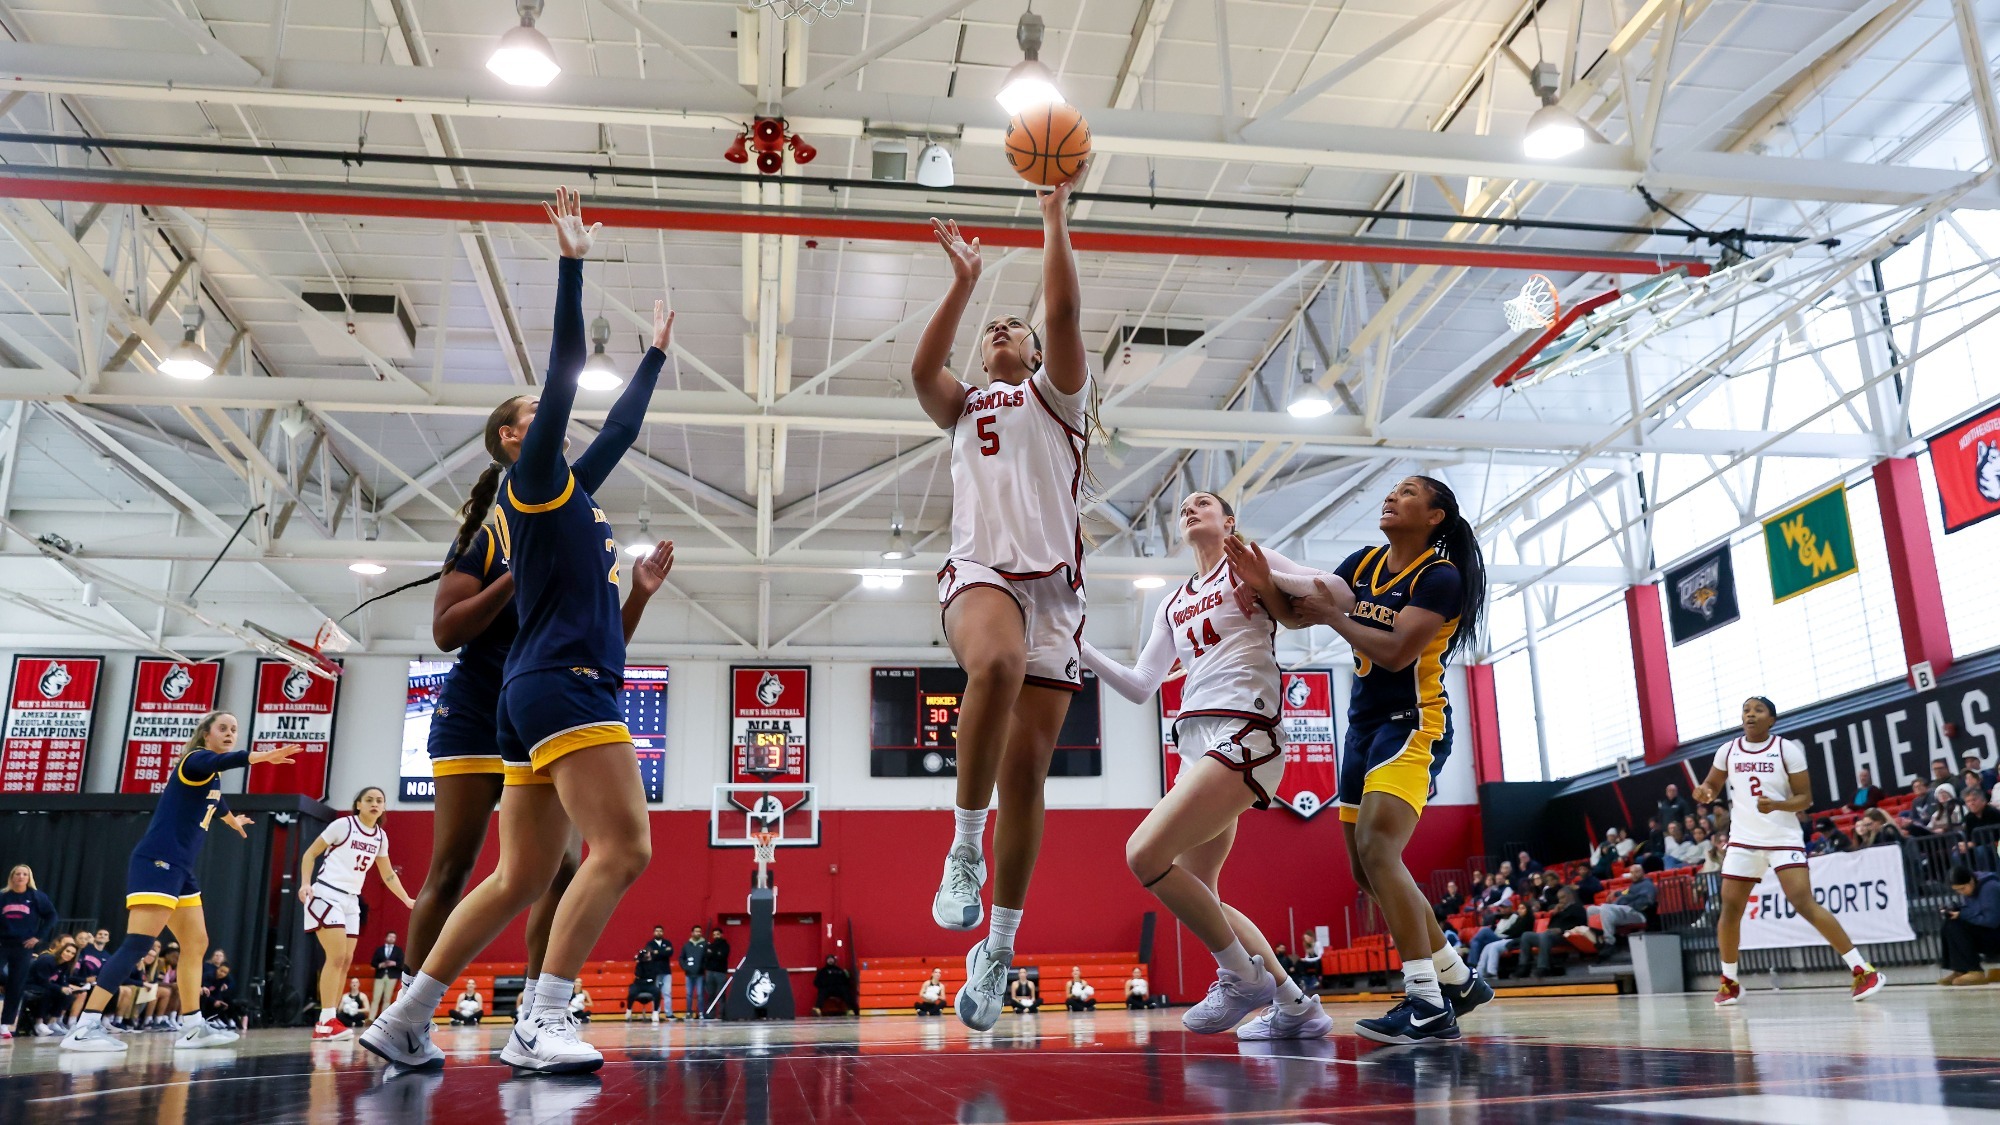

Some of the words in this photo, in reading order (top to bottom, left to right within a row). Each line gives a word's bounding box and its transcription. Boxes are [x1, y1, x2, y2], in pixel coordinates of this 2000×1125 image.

[960, 390, 1024, 418] USKIES
[976, 415, 1000, 456] 5
[1780, 512, 1838, 578] W&M
[1173, 590, 1222, 628] HUSKIES
[1353, 600, 1398, 627] EXE
[1187, 618, 1221, 658] 14
[1918, 672, 1929, 688] B
[163, 703, 206, 711] BASKETBALL
[926, 697, 956, 705] HUSKIES
[136, 717, 179, 725] AMERICA
[277, 716, 310, 730] NIT
[930, 709, 948, 723] 30
[12, 727, 86, 737] CHAMPIONS
[134, 727, 195, 737] CHAMPION
[748, 721, 792, 733] NCAA
[258, 732, 325, 740] APPEARANCES
[758, 734, 784, 746] 6:47
[930, 732, 937, 740] 4
[140, 744, 162, 754] 1981
[136, 756, 162, 767] 1984
[768, 746, 780, 767] 3
[134, 769, 159, 779] 1986
[1735, 762, 1774, 773] HUSKIES
[1749, 776, 1762, 796] 2
[351, 840, 377, 854] HUSKIES
[354, 854, 370, 872] 15
[1761, 879, 1888, 919] FLOPORTS
